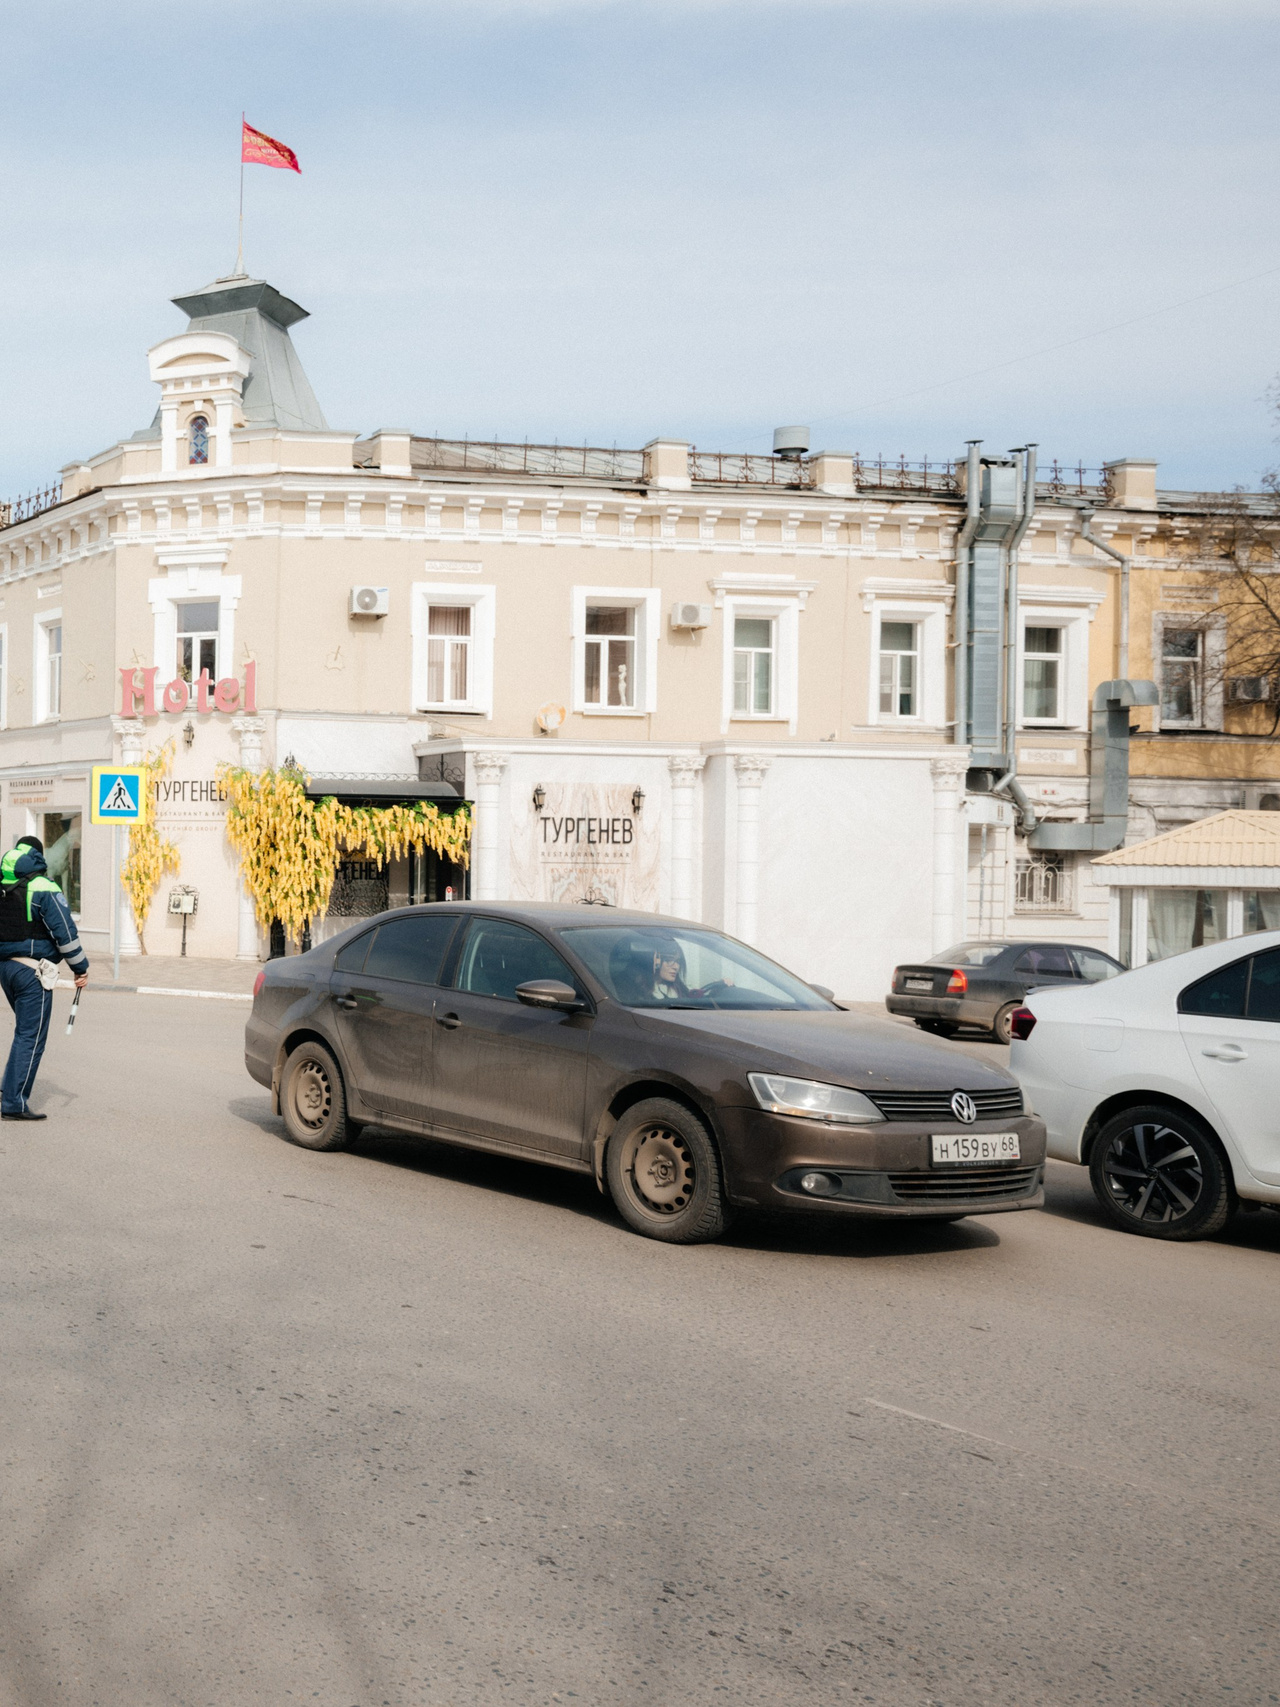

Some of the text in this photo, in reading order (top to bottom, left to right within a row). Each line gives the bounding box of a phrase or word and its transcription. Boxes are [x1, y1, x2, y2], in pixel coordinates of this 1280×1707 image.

[118, 660, 258, 717] Hotel
[540, 816, 634, 844] ТУРГЕНЕВ
[1001, 1136, 1015, 1151] 68
